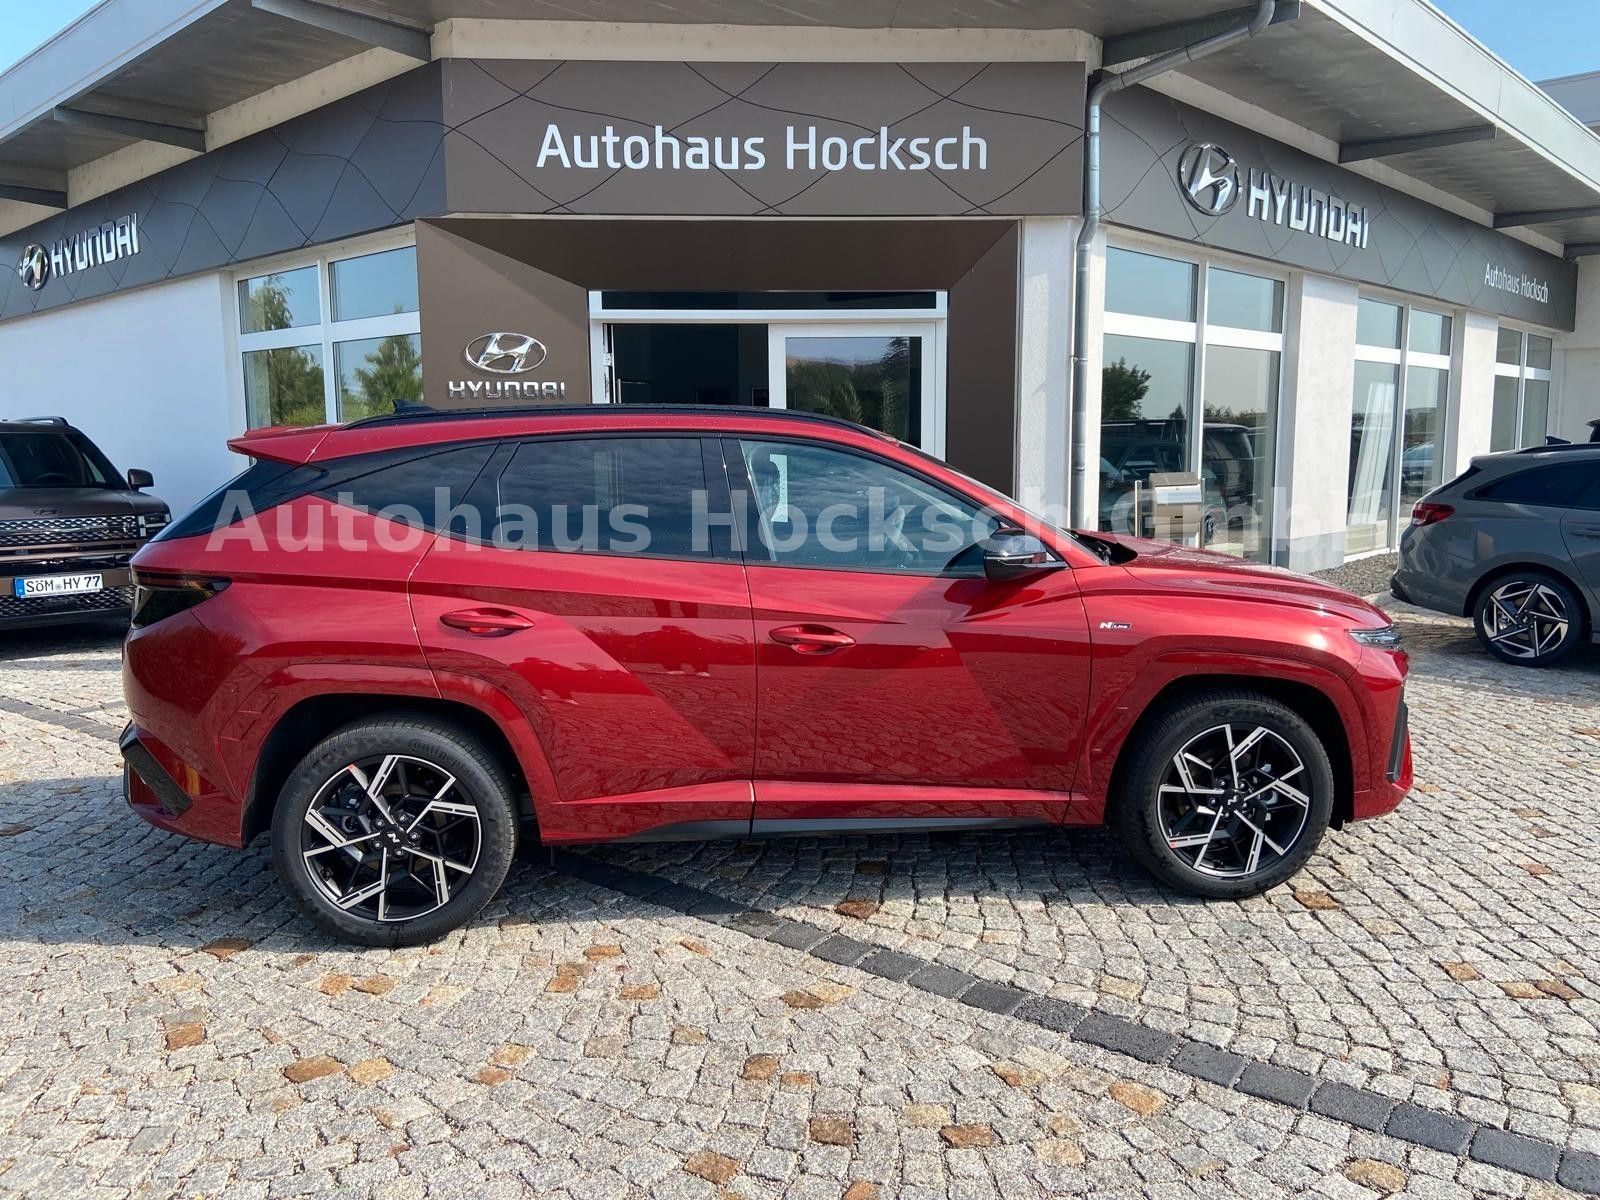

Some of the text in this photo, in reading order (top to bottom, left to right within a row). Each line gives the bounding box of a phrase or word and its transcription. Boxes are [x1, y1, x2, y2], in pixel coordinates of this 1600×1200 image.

[536, 124, 988, 171] Autohaus Hocksch
[1246, 167, 1370, 249] HYUNDAI
[50, 212, 140, 278] HYUNDAI
[1484, 261, 1549, 304] Autohaus Hocksch
[448, 381, 566, 399] HYUNDAI
[26, 575, 101, 593] SÖM HY 77
